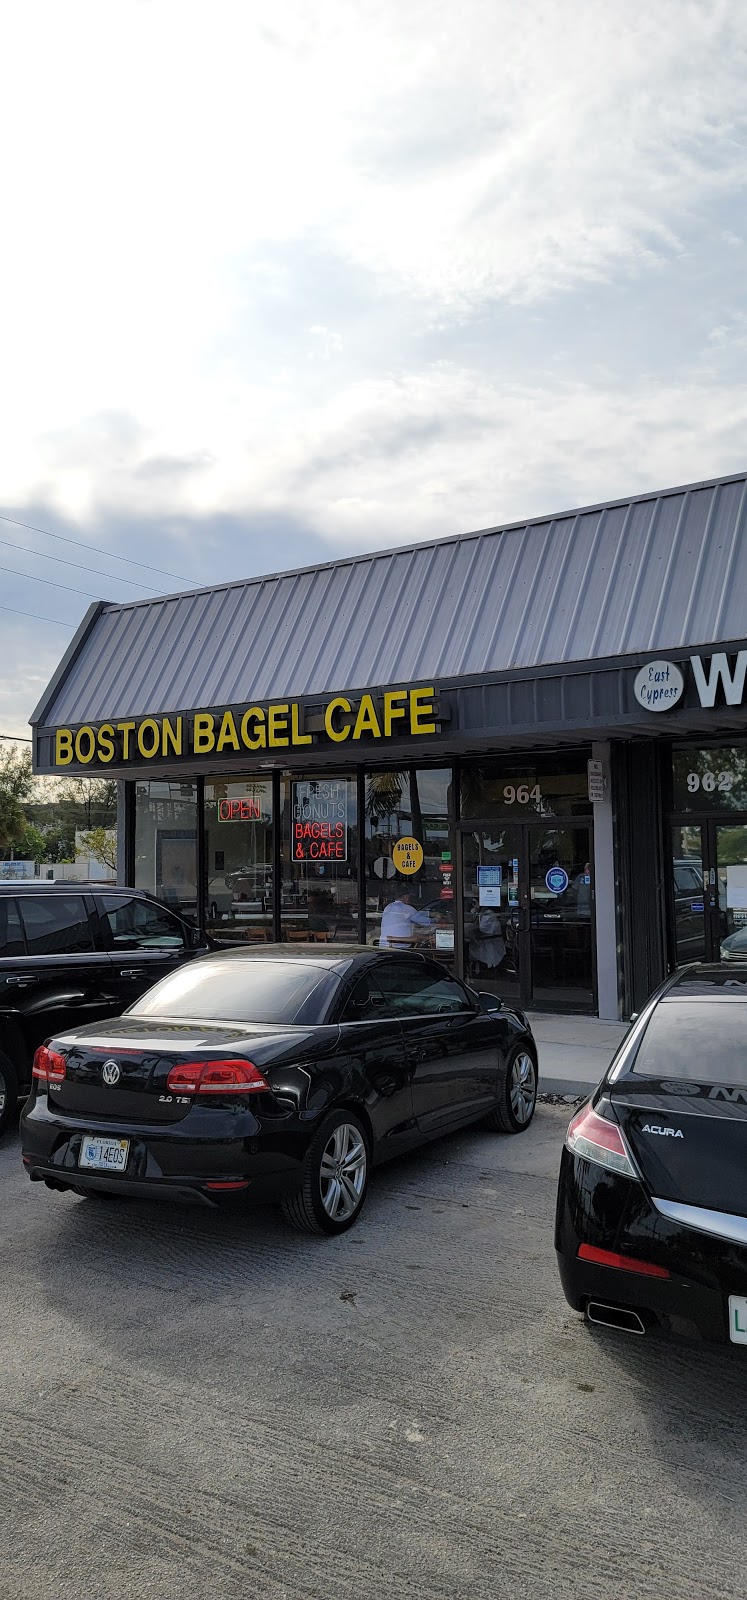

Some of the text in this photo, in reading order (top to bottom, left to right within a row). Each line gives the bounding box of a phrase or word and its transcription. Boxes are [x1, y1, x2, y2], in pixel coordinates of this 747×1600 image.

[648, 665, 670, 682] East
[640, 684, 679, 704] Cypress
[55, 687, 436, 766] BOSTON BAGEL CAFE
[687, 771, 733, 792] 962
[299, 783, 339, 800] FRESH
[503, 784, 543, 804] 964
[219, 798, 260, 820] OPEN
[293, 803, 345, 819] DONUTS
[295, 822, 344, 838] BAGELS
[295, 842, 344, 858] & CAFE
[397, 843, 419, 852] BAGELS
[402, 860, 416, 868] CAFE
[406, 852, 411, 860] &
[642, 1124, 684, 1139] ACURA
